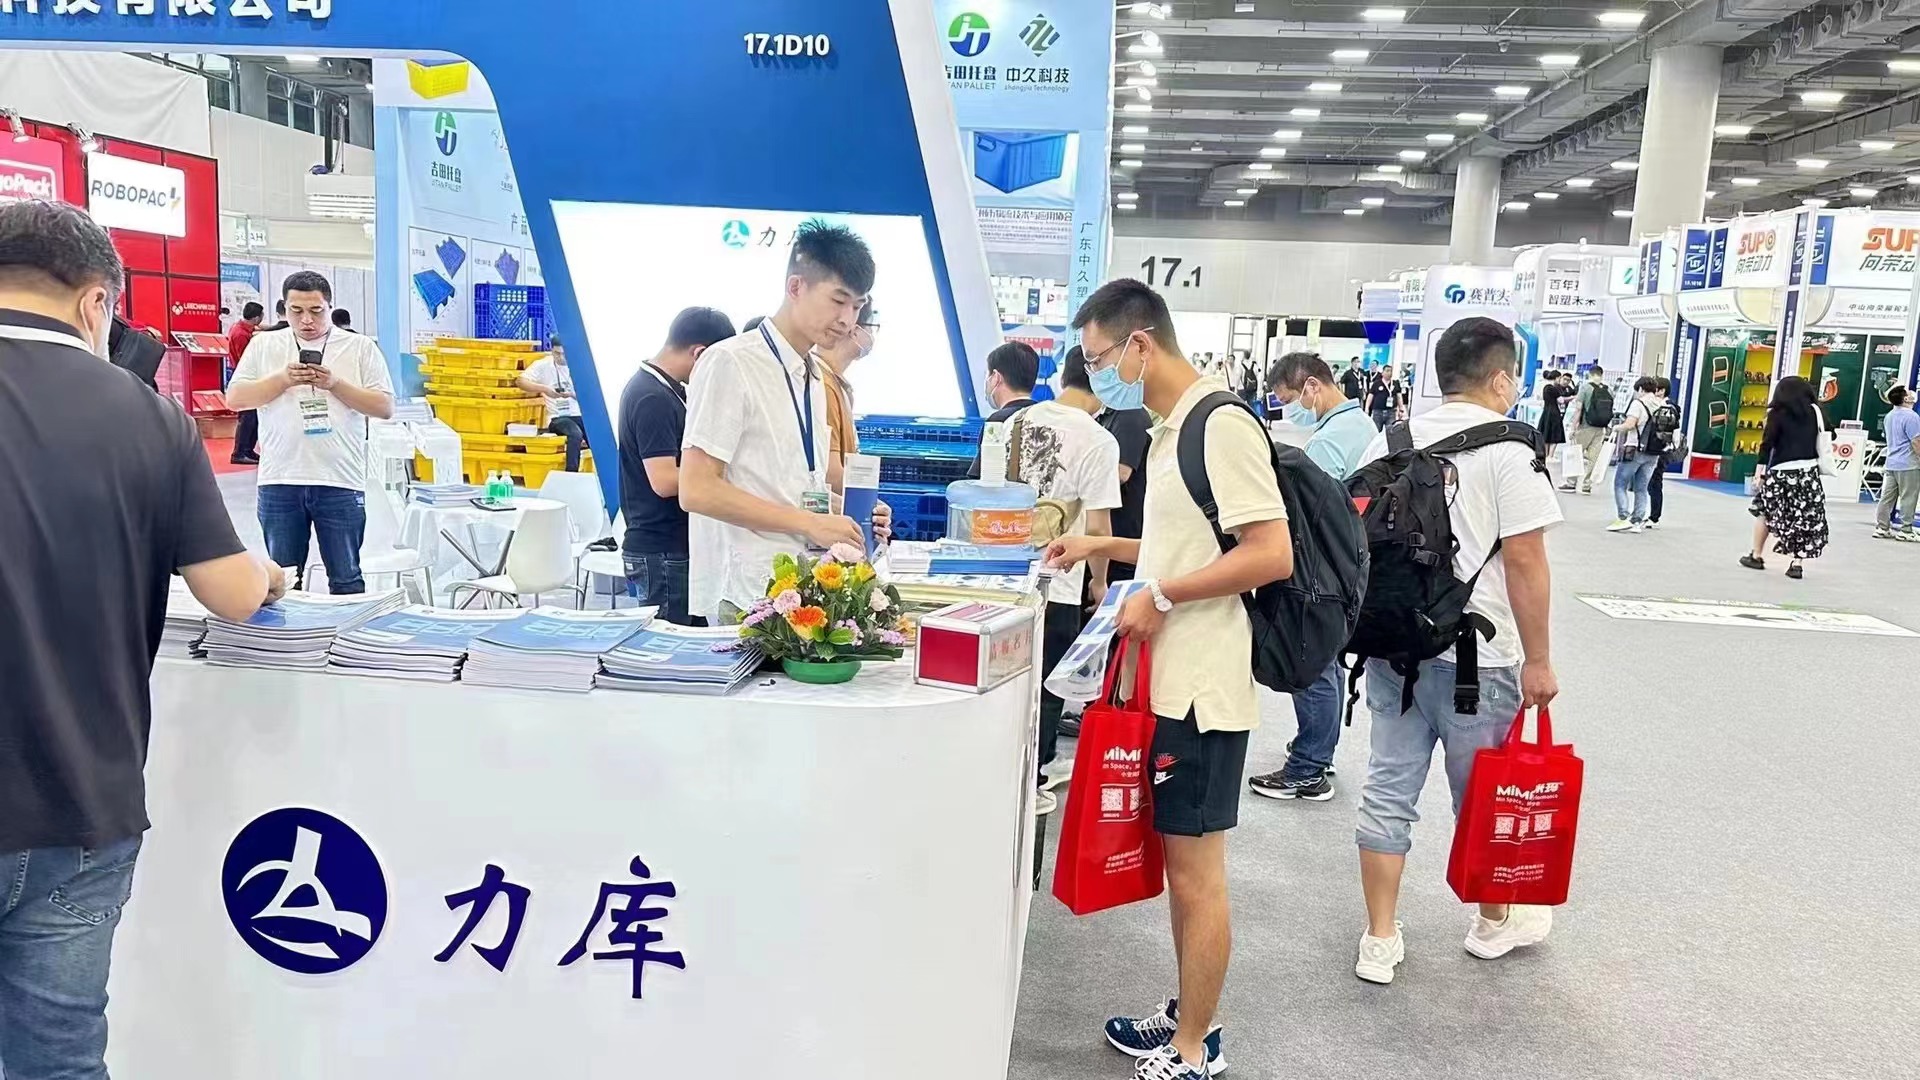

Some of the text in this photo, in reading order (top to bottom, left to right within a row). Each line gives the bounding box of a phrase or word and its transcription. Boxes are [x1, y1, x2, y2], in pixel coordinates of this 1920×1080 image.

[743, 32, 830, 56] 17.1D10
[964, 82, 996, 90] PALLET
[1006, 67, 1070, 83] 中久科技
[91, 179, 167, 208] ROBOPAC
[1737, 229, 1777, 255] SUPO
[1141, 256, 1202, 287] 17.1
[434, 855, 687, 1000] 力库
